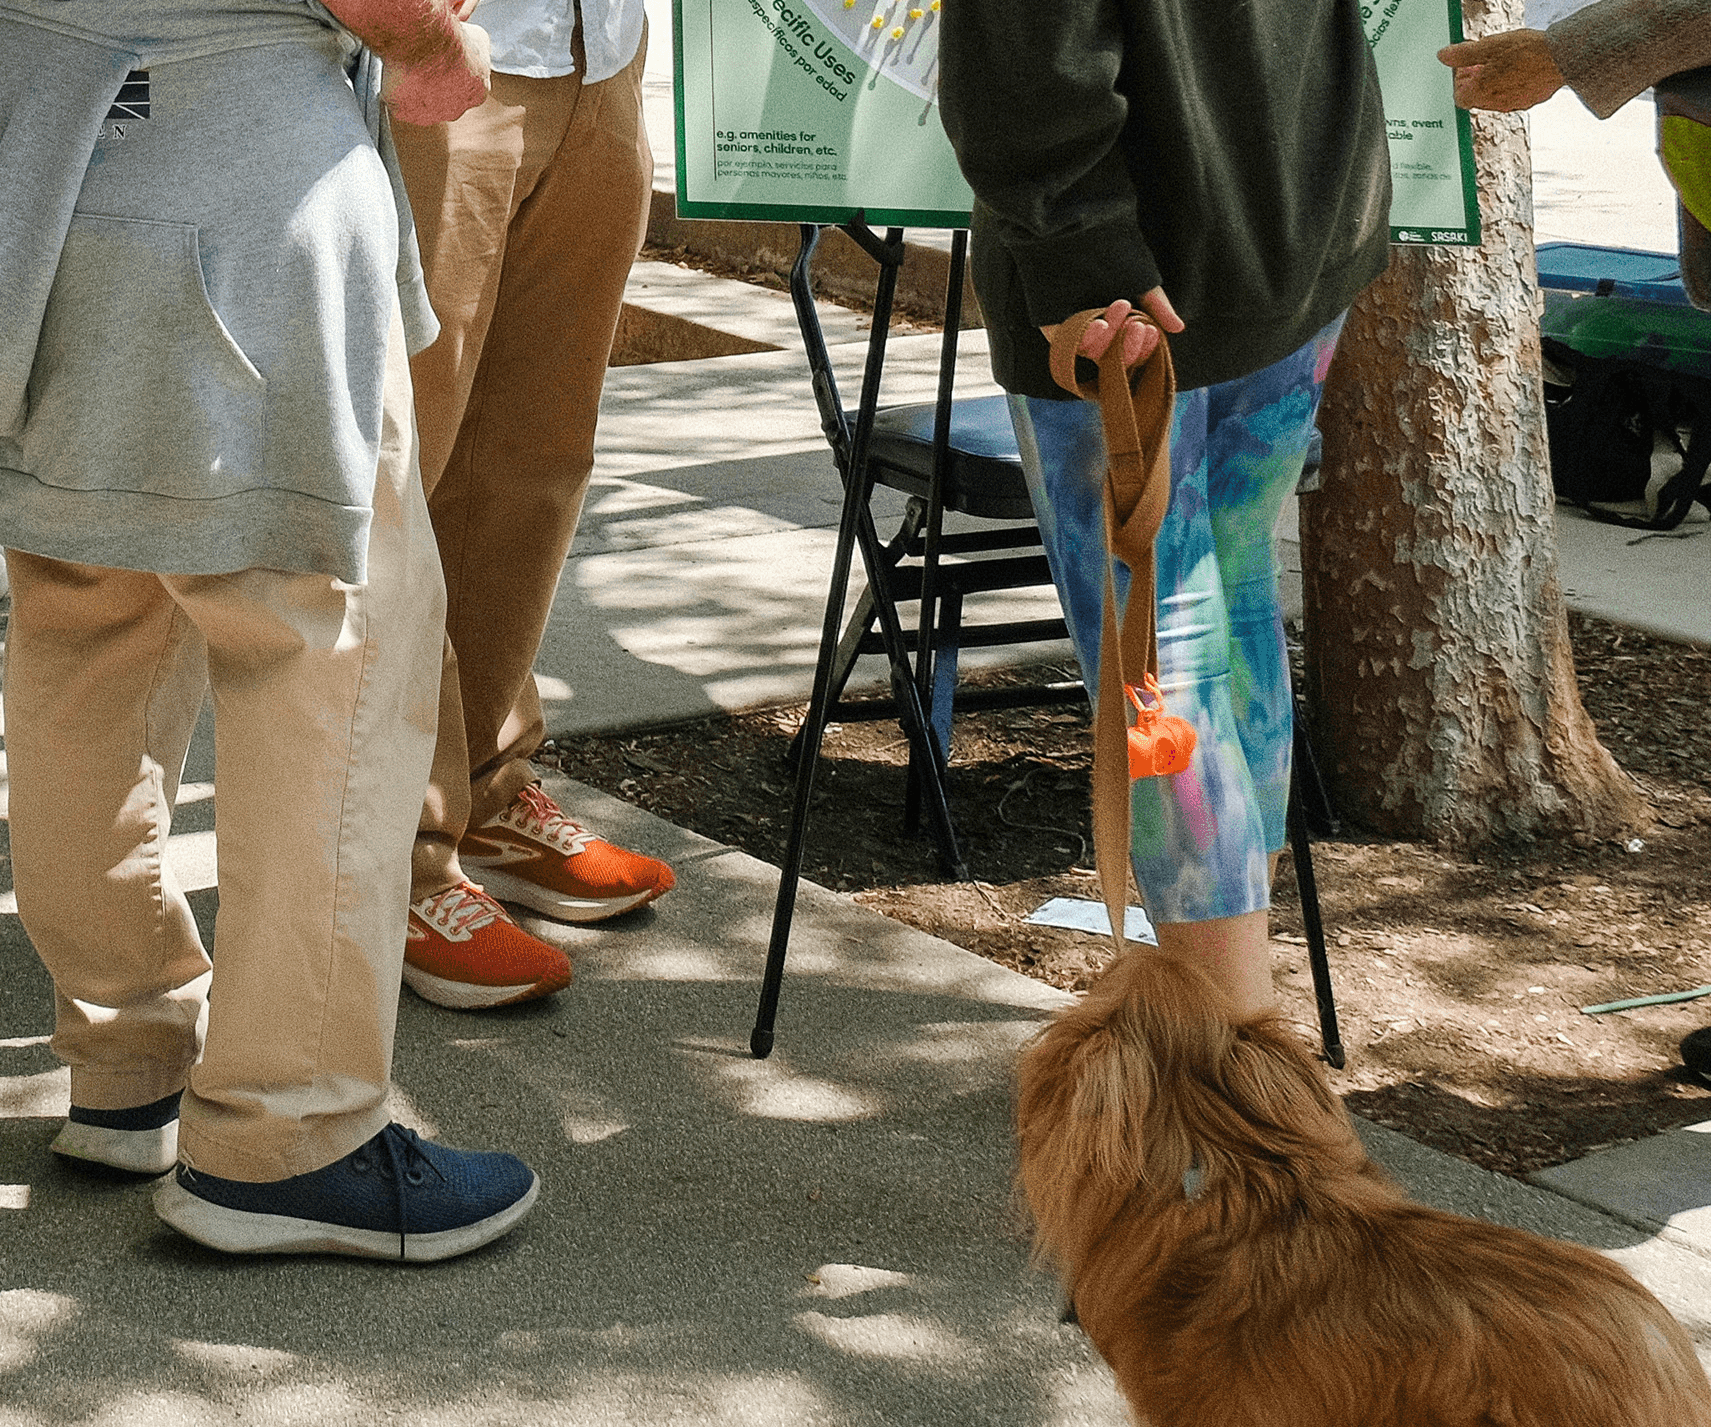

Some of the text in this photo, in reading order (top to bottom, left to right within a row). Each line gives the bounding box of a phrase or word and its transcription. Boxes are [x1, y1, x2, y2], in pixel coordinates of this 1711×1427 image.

[813, 41, 856, 85] Uses
[793, 56, 817, 76] por
[815, 75, 848, 102] edad
[1411, 118, 1444, 129] event
[716, 130, 817, 142] e.g. amenities for
[716, 142, 762, 154] seniors,
[1430, 231, 1468, 242] SASAKI
